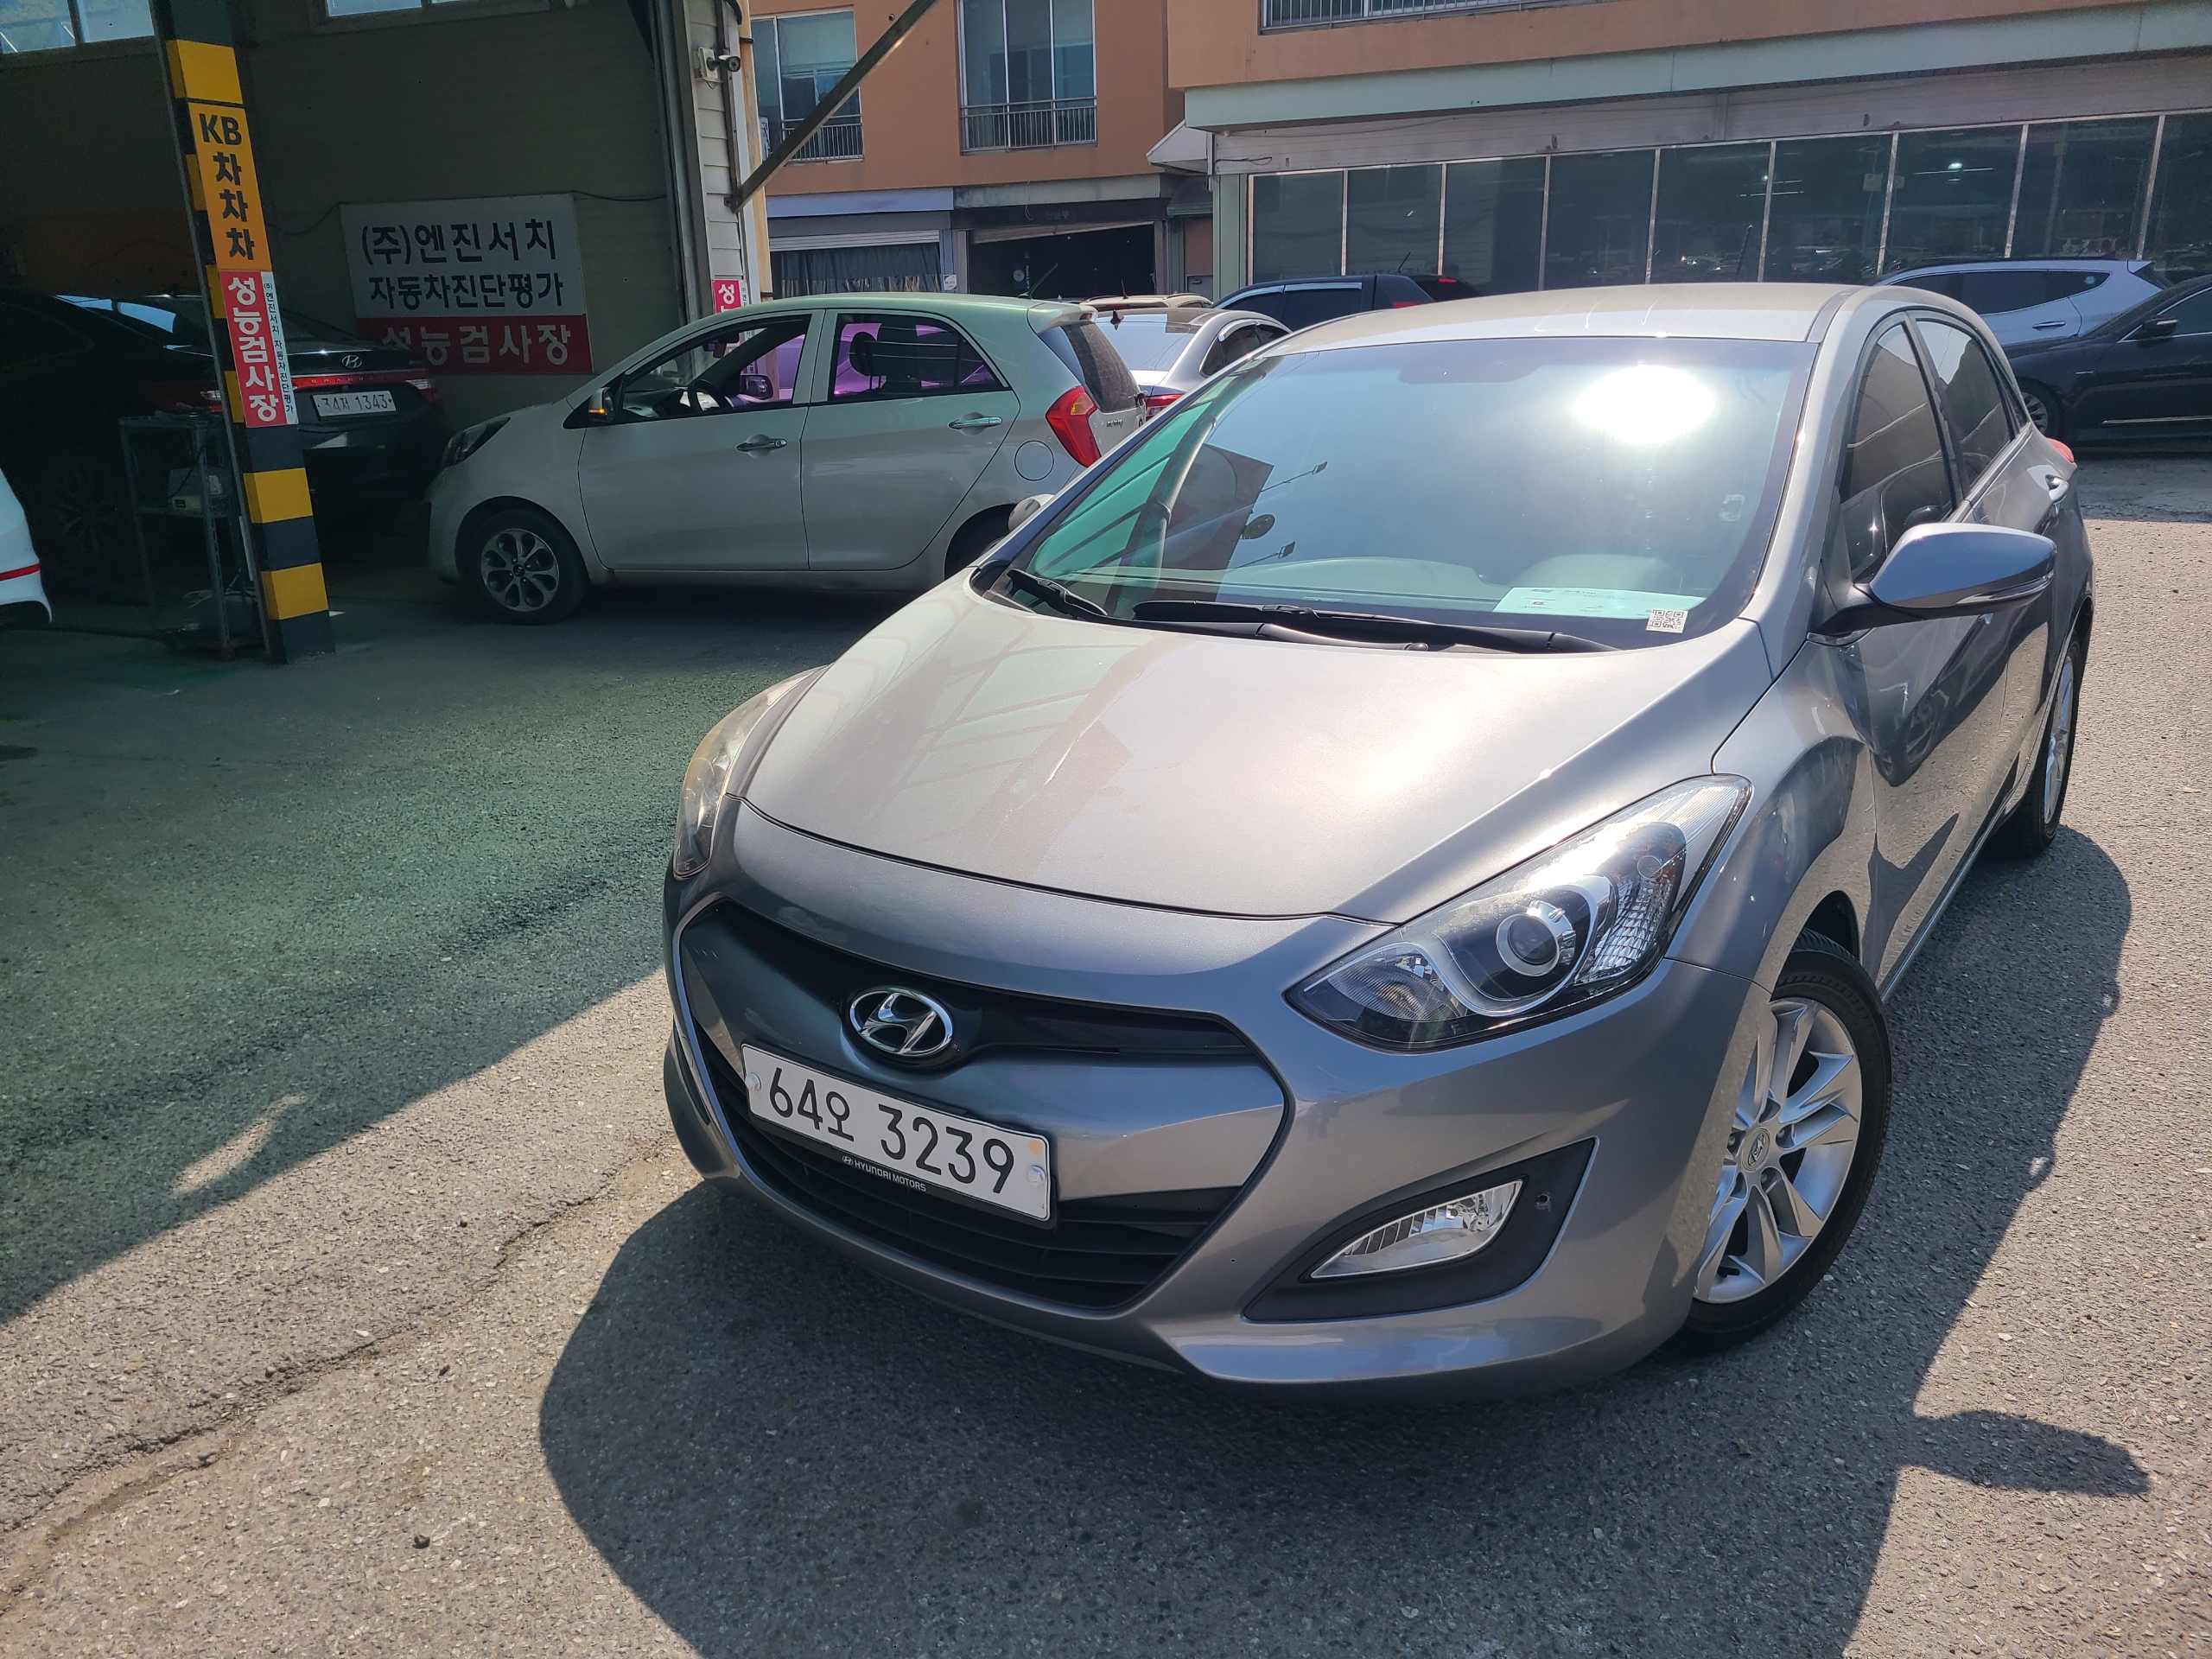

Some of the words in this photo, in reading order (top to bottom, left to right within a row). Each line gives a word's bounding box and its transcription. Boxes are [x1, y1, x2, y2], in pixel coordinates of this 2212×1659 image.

[199, 113, 242, 146] KB
[212, 151, 255, 261] 차차차
[362, 219, 556, 265] (주)엔진서치
[369, 273, 563, 309] 자동차진단평가
[227, 276, 280, 423] 성능검사장
[355, 394, 388, 410] 1343
[769, 1067, 855, 1142] 64오
[878, 1103, 1014, 1194] 3239
[854, 1160, 892, 1180] HYUNDAI
[893, 1174, 926, 1192] MOTORS
